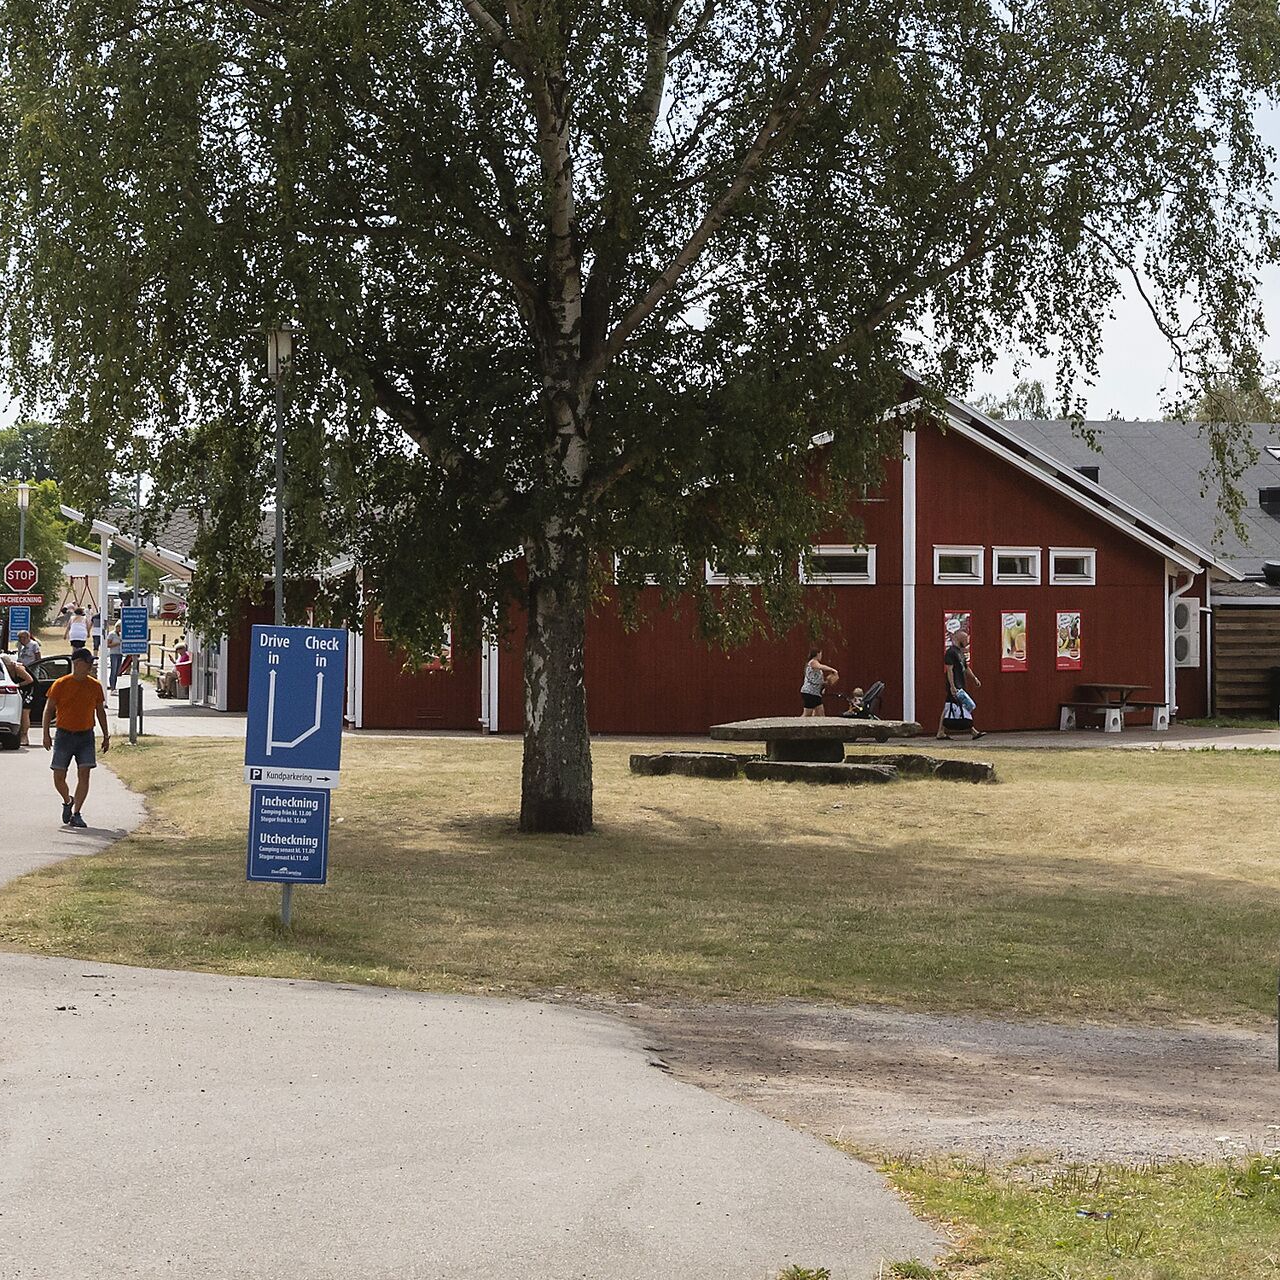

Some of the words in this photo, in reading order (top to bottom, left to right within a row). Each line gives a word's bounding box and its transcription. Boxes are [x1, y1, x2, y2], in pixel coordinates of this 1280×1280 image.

[8, 570, 35, 580] STOP
[260, 633, 290, 648] Drive
[305, 636, 339, 651] Check
[268, 651, 279, 664] in
[315, 654, 327, 667] in
[252, 770, 260, 779] P
[266, 771, 312, 783] Kundparkering
[262, 796, 319, 811] Incheckning
[260, 833, 318, 848] Utcheckning
